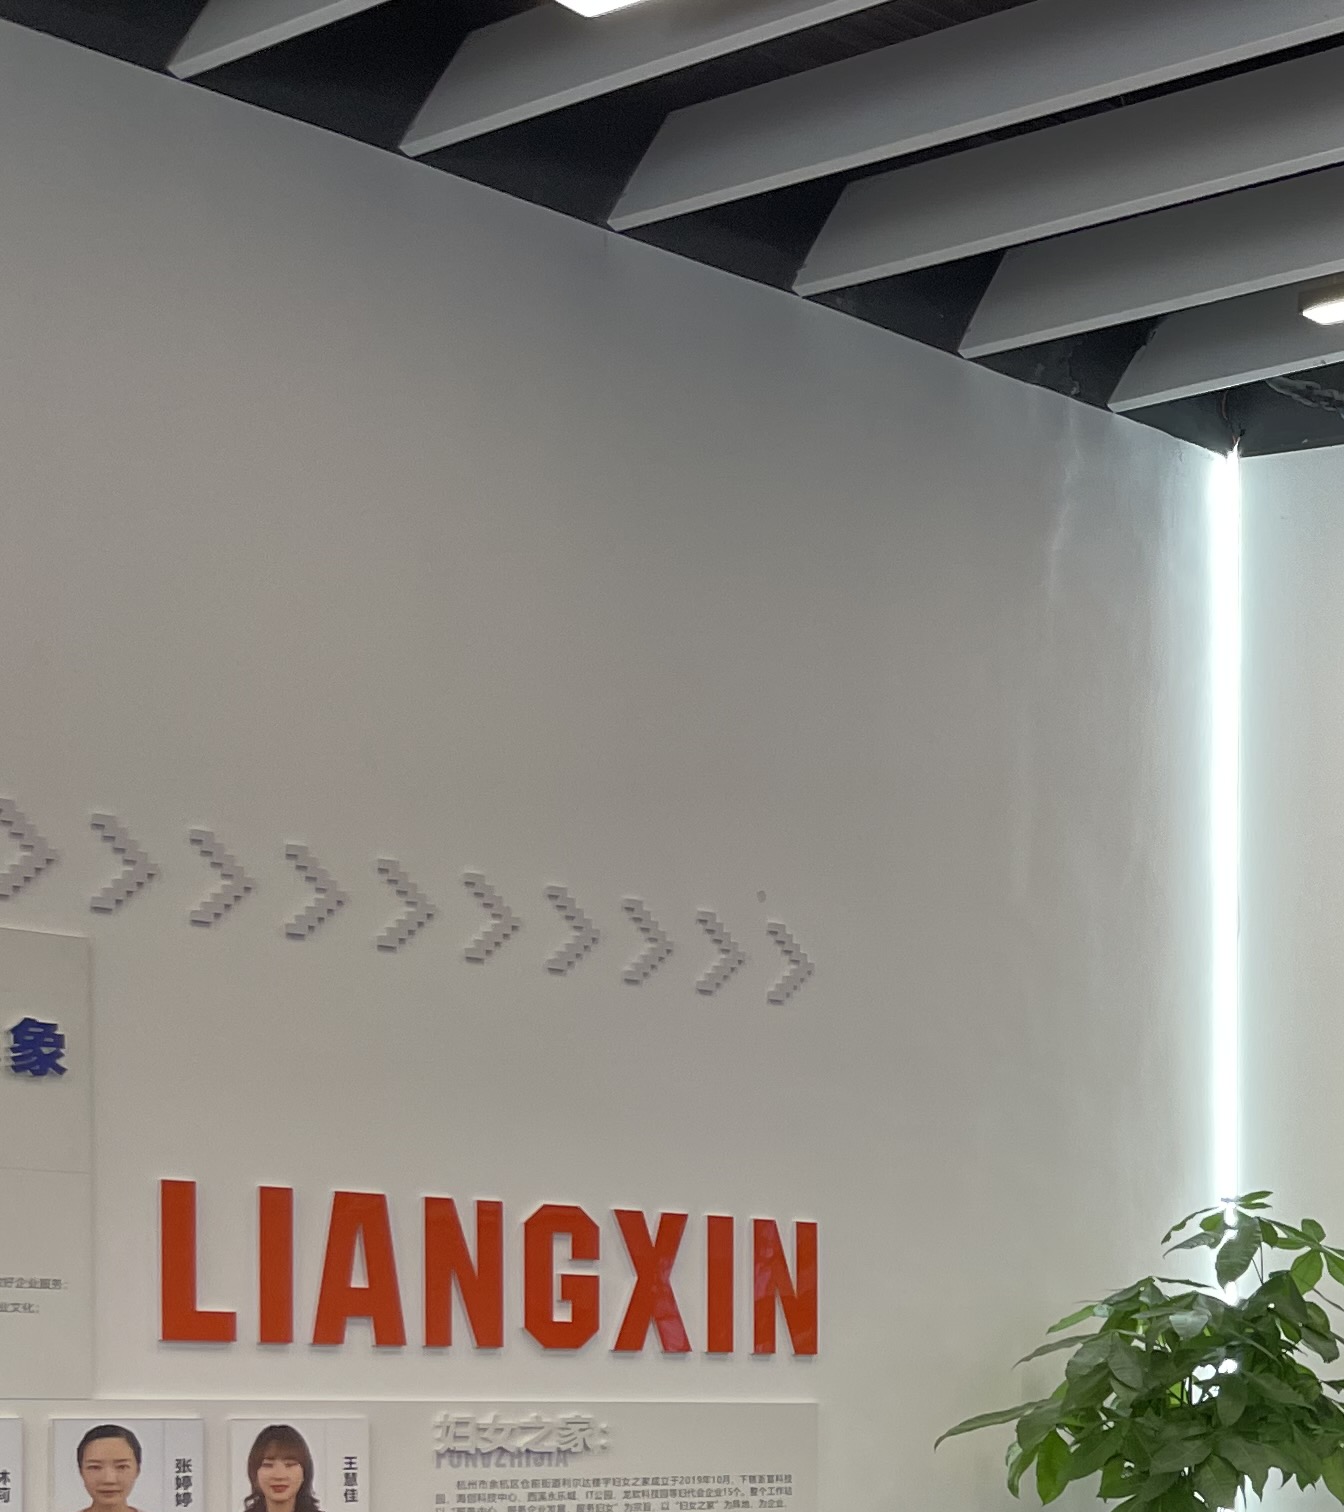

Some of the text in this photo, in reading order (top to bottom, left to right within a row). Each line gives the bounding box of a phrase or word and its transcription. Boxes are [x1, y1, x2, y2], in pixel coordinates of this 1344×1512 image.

[5, 1016, 68, 1079] 象
[159, 1179, 818, 1357] LIANGXIN
[174, 1458, 193, 1508] 张婷婷
